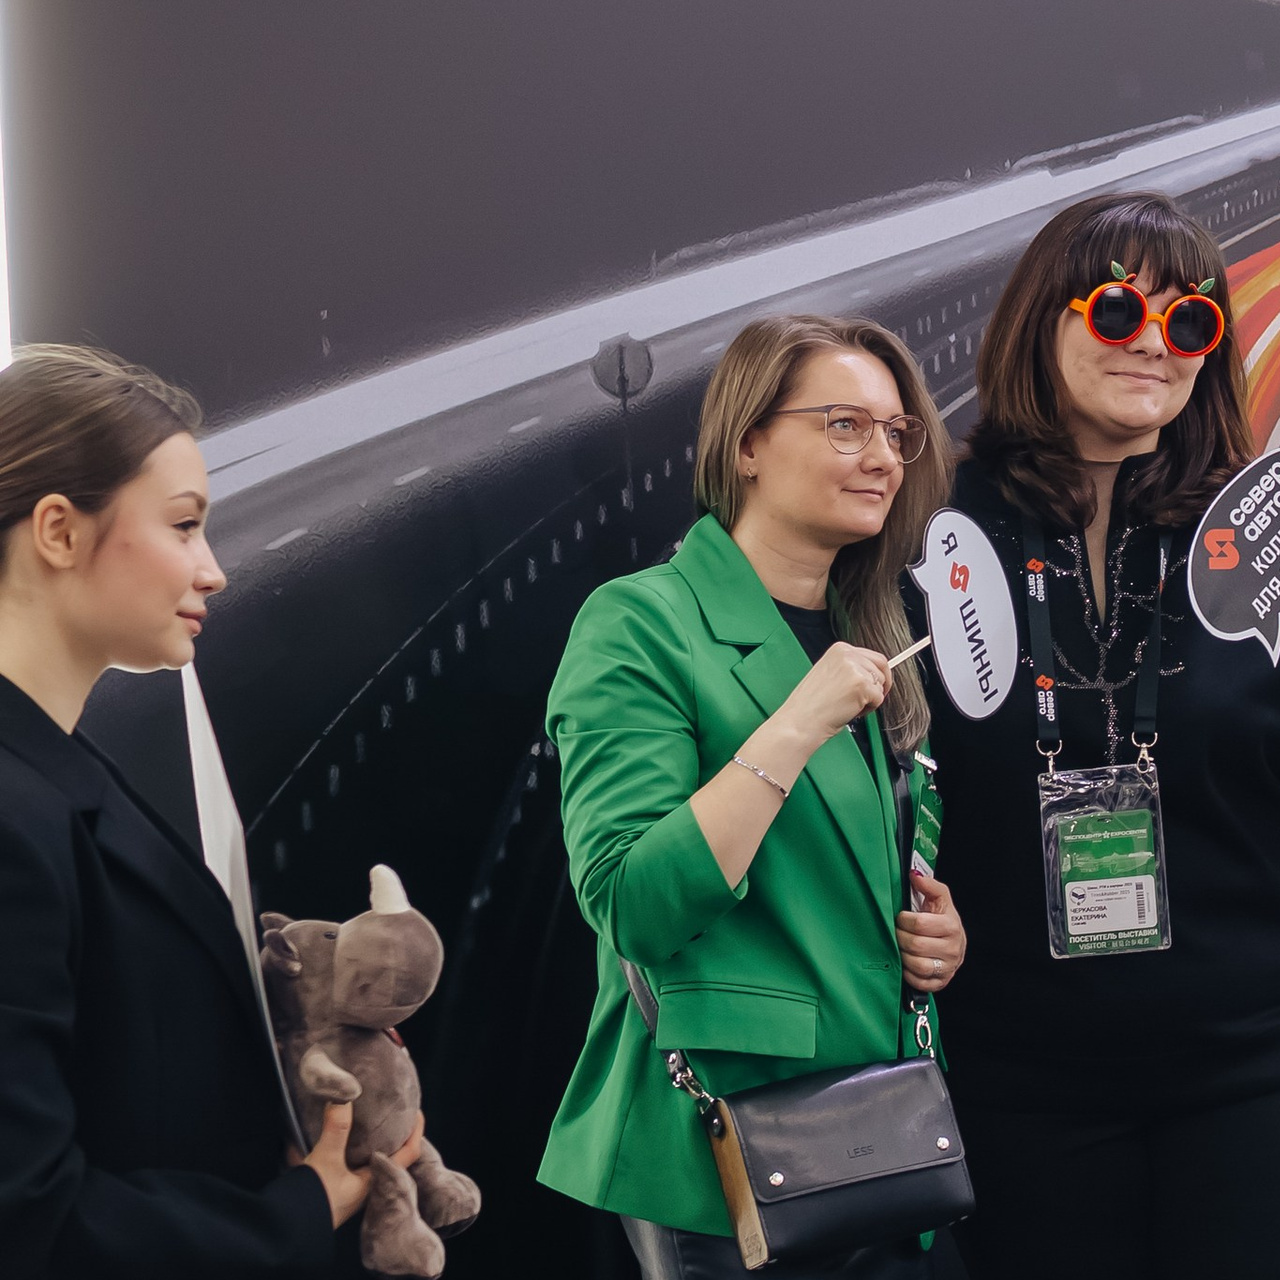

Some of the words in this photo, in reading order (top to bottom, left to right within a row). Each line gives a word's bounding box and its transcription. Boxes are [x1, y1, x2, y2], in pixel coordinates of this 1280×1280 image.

[1028, 573, 1036, 597] авто
[1036, 573, 1045, 602] север
[941, 531, 959, 557] Я
[959, 597, 998, 703] ШИНЫ
[1037, 690, 1046, 715] авто
[1046, 690, 1055, 721] север
[1069, 933, 1117, 944] ПОСЕТИТЕЛЬ
[1118, 929, 1158, 939] ВЫСТАВКИ
[1078, 942, 1107, 951] VISITOR
[846, 1144, 874, 1160] LESS
